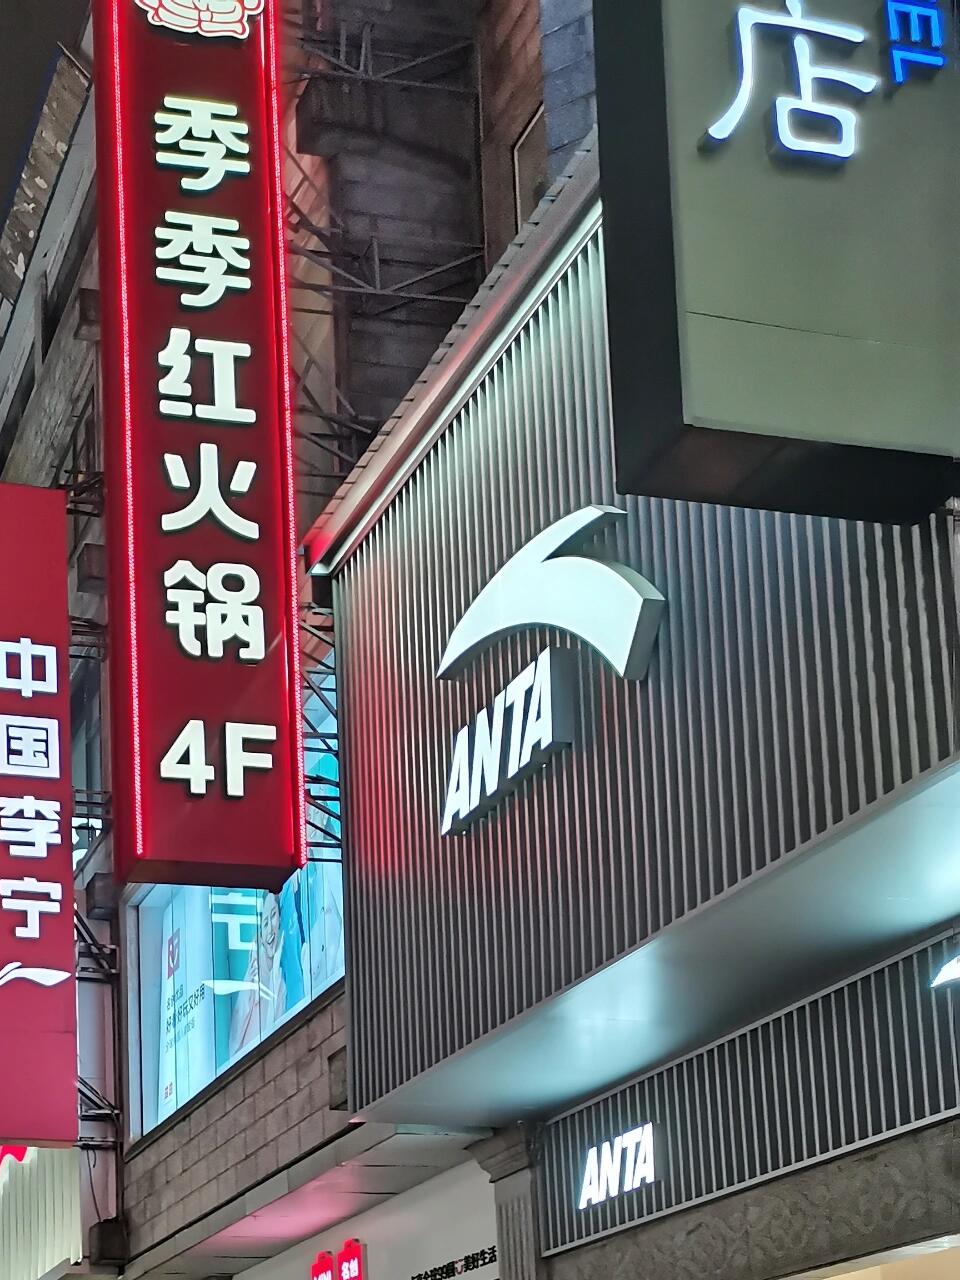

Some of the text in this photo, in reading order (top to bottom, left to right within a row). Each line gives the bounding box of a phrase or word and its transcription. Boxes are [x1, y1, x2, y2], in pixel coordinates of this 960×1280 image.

[707, 0, 879, 158] 店
[886, 0, 945, 83] EL
[154, 95, 278, 800] 季季红火锅 4F
[441, 645, 554, 836] ANTA
[578, 1122, 656, 1211] ANTA
[341, 1257, 360, 1280] 名创
